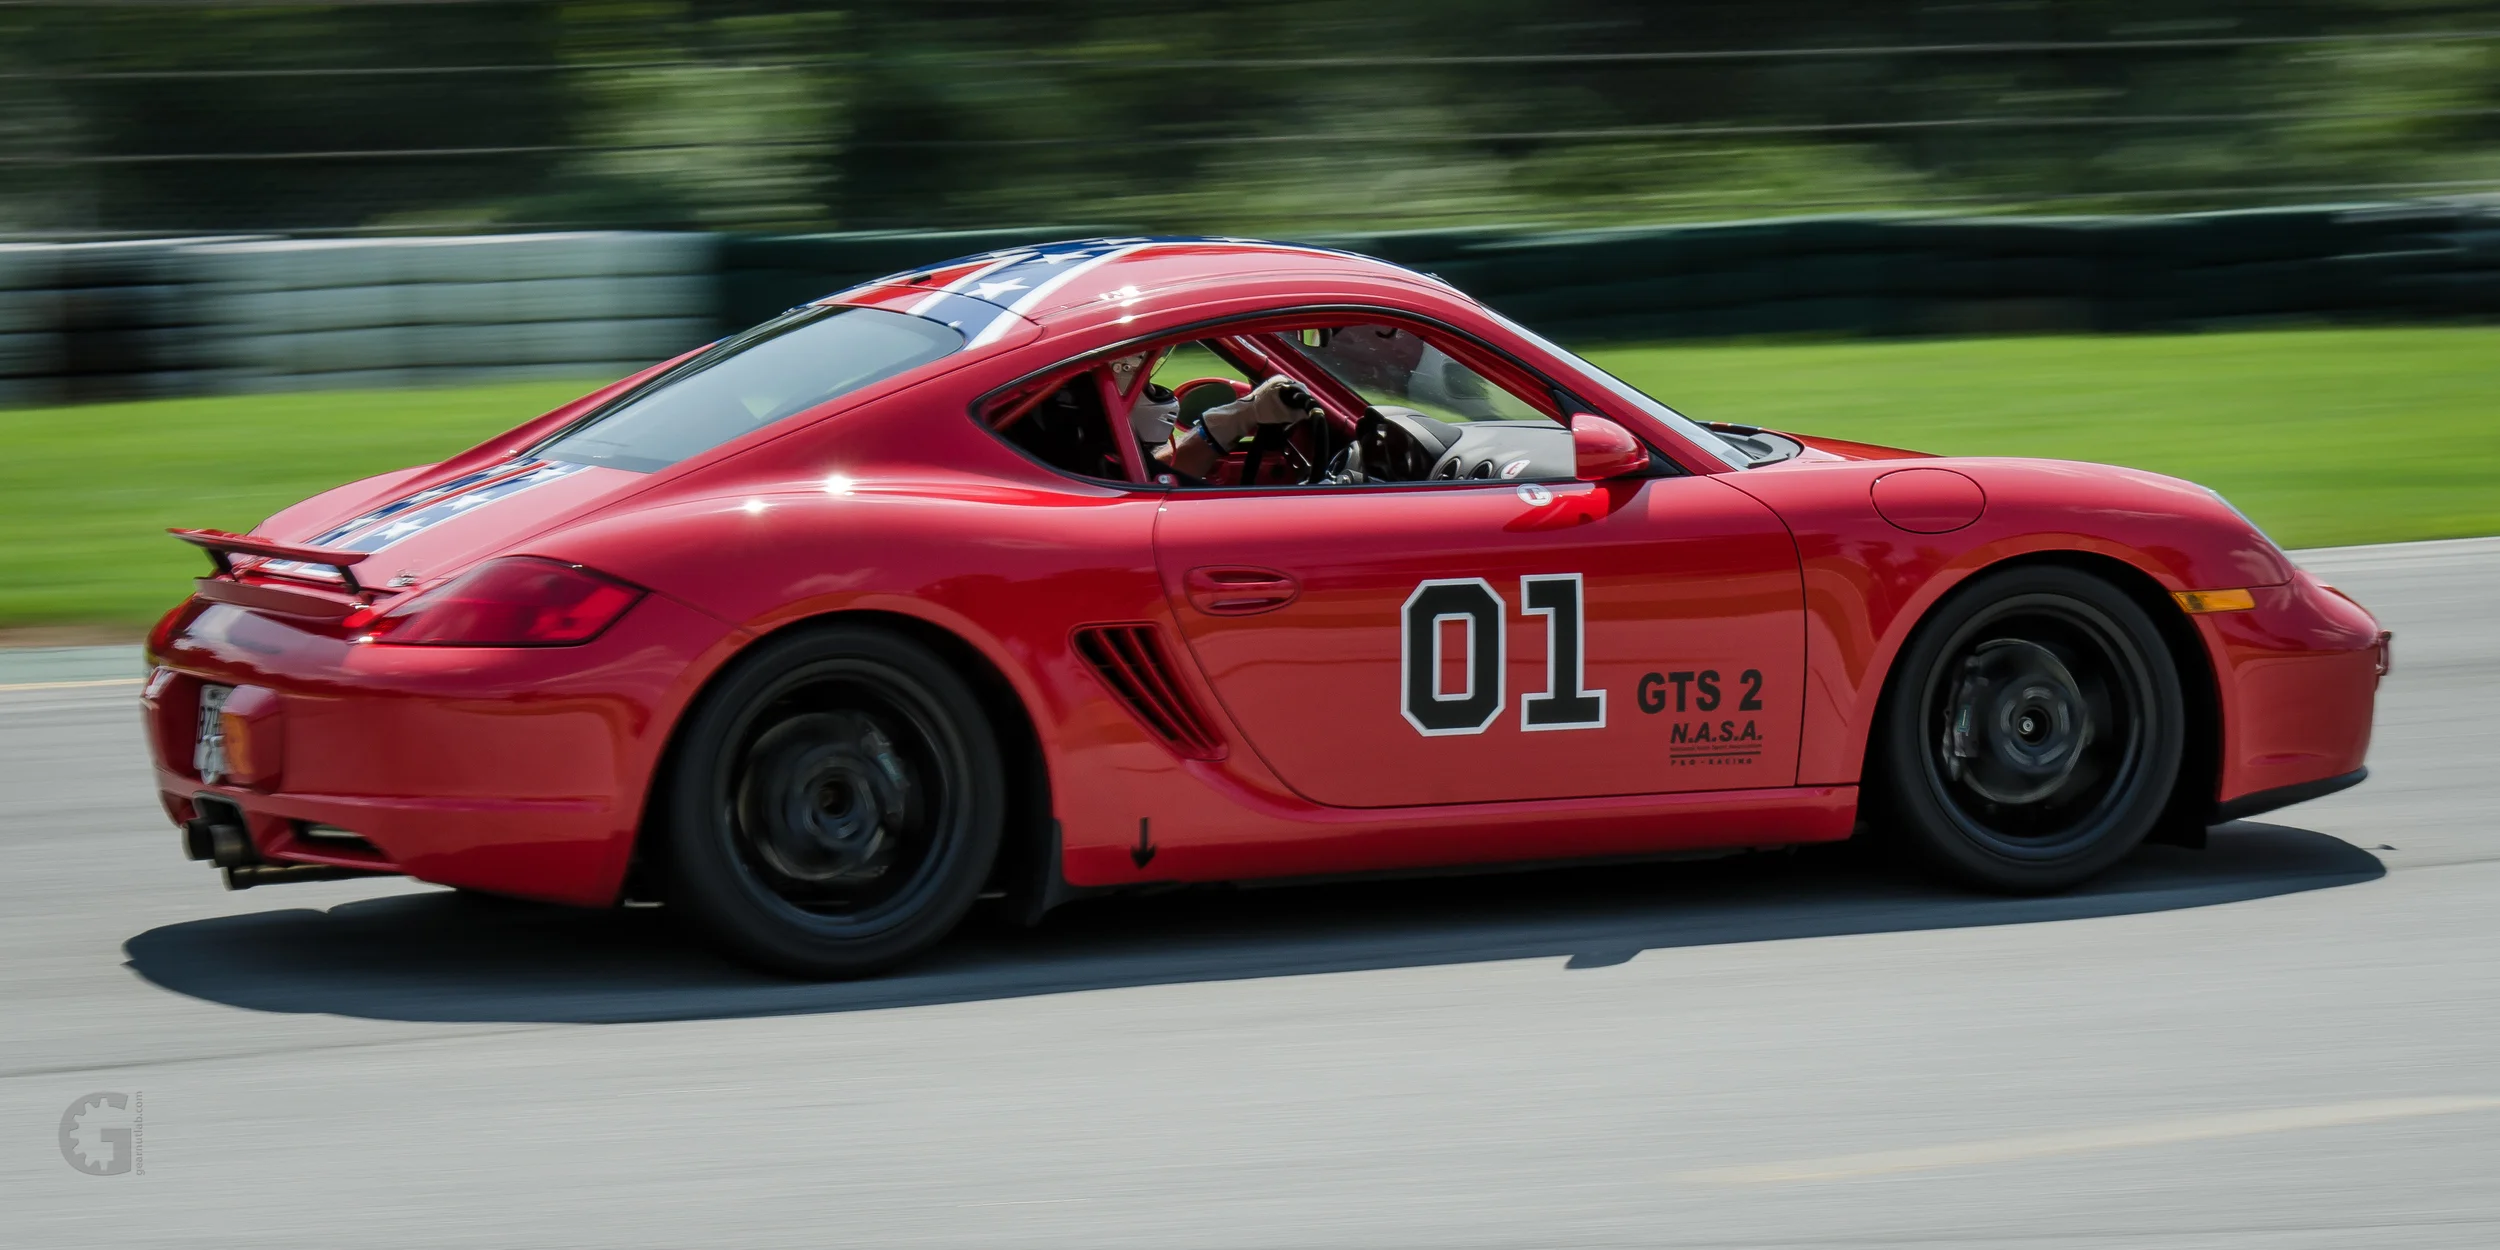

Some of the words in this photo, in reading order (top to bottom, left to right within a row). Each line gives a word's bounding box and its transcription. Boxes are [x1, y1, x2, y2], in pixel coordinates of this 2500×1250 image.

[1401, 573, 1607, 737] 01
[1637, 670, 1721, 714] GTS
[1739, 669, 1762, 711] 2
[1670, 720, 1762, 743] N.A.S.A.
